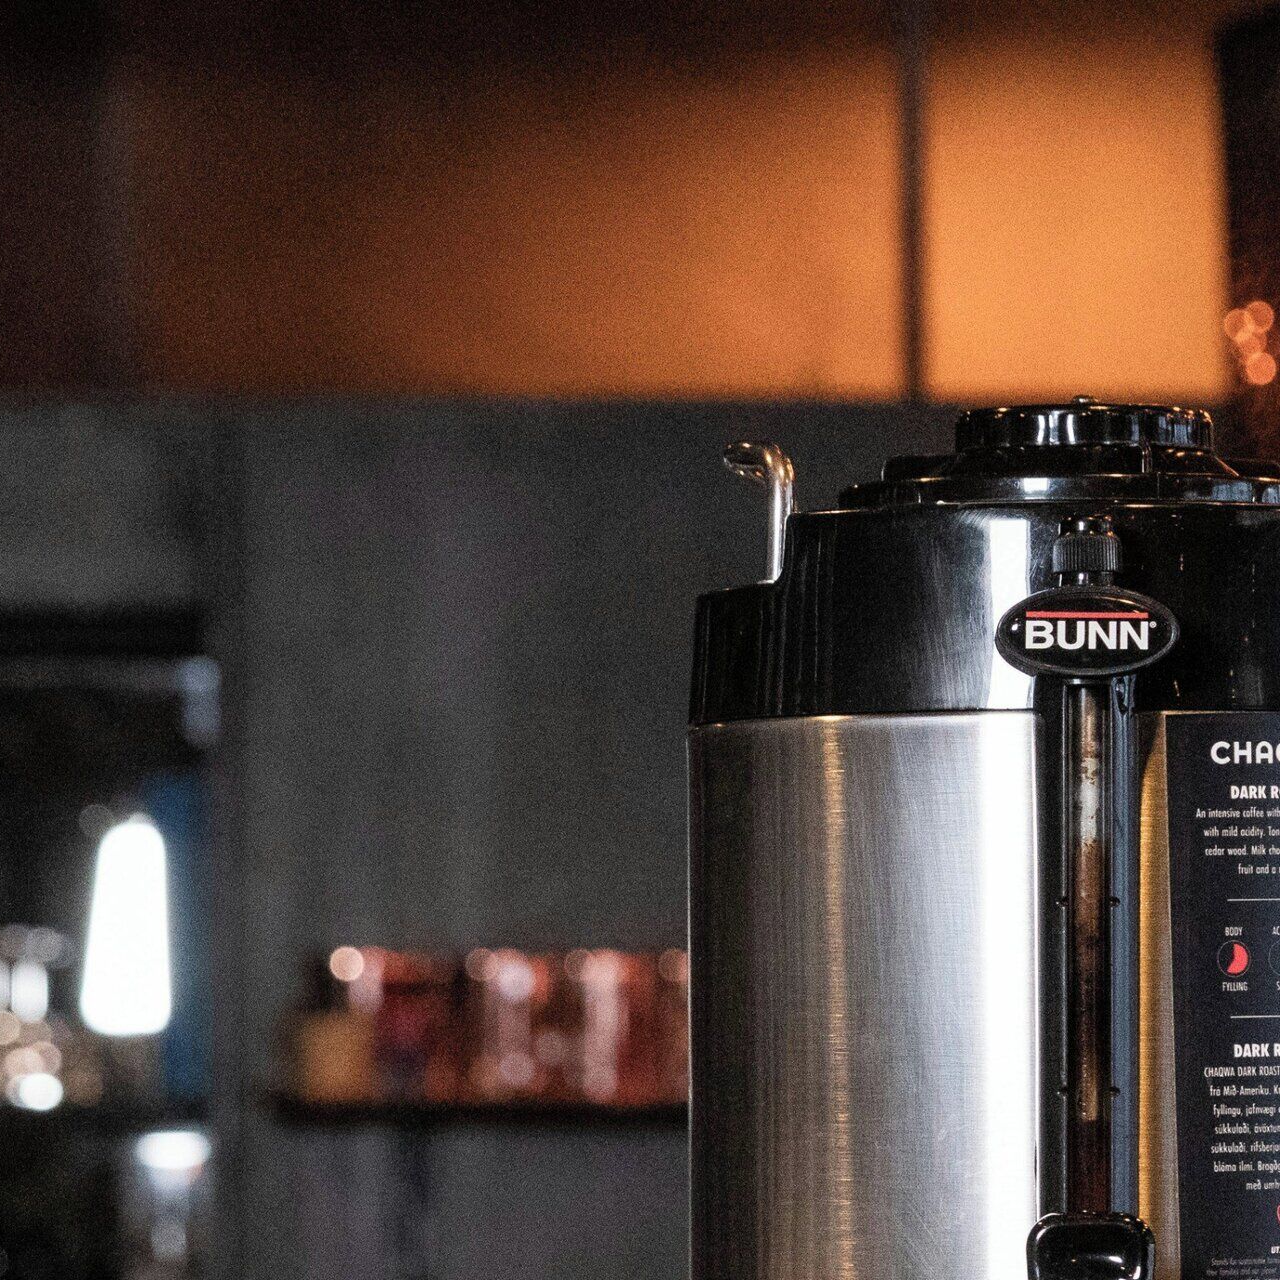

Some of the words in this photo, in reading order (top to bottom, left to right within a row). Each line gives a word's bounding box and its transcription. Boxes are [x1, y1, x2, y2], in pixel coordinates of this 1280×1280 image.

[1231, 786, 1266, 799] DARK
[1196, 808, 1205, 818] An
[1208, 808, 1240, 818] intensive
[1243, 807, 1264, 817] coffee
[1267, 808, 1280, 817] with
[1204, 826, 1219, 836] with
[1222, 826, 1237, 836] mild
[1241, 826, 1265, 838] acidity.
[1205, 845, 1224, 856] cedar
[1228, 845, 1247, 855] wood.
[1251, 845, 1265, 855] Milk
[1238, 864, 1253, 874] fruit
[1256, 864, 1269, 874] and
[1225, 927, 1243, 936] BODY
[1222, 982, 1248, 991] FYLLING
[1234, 1044, 1269, 1058] DARK
[1204, 1067, 1235, 1077] CHAQWA
[1238, 1066, 1256, 1076] DARK
[1259, 1066, 1280, 1076] ROAST
[1246, 1104, 1276, 1116] jafnvægi
[1246, 1179, 1261, 1190] með
